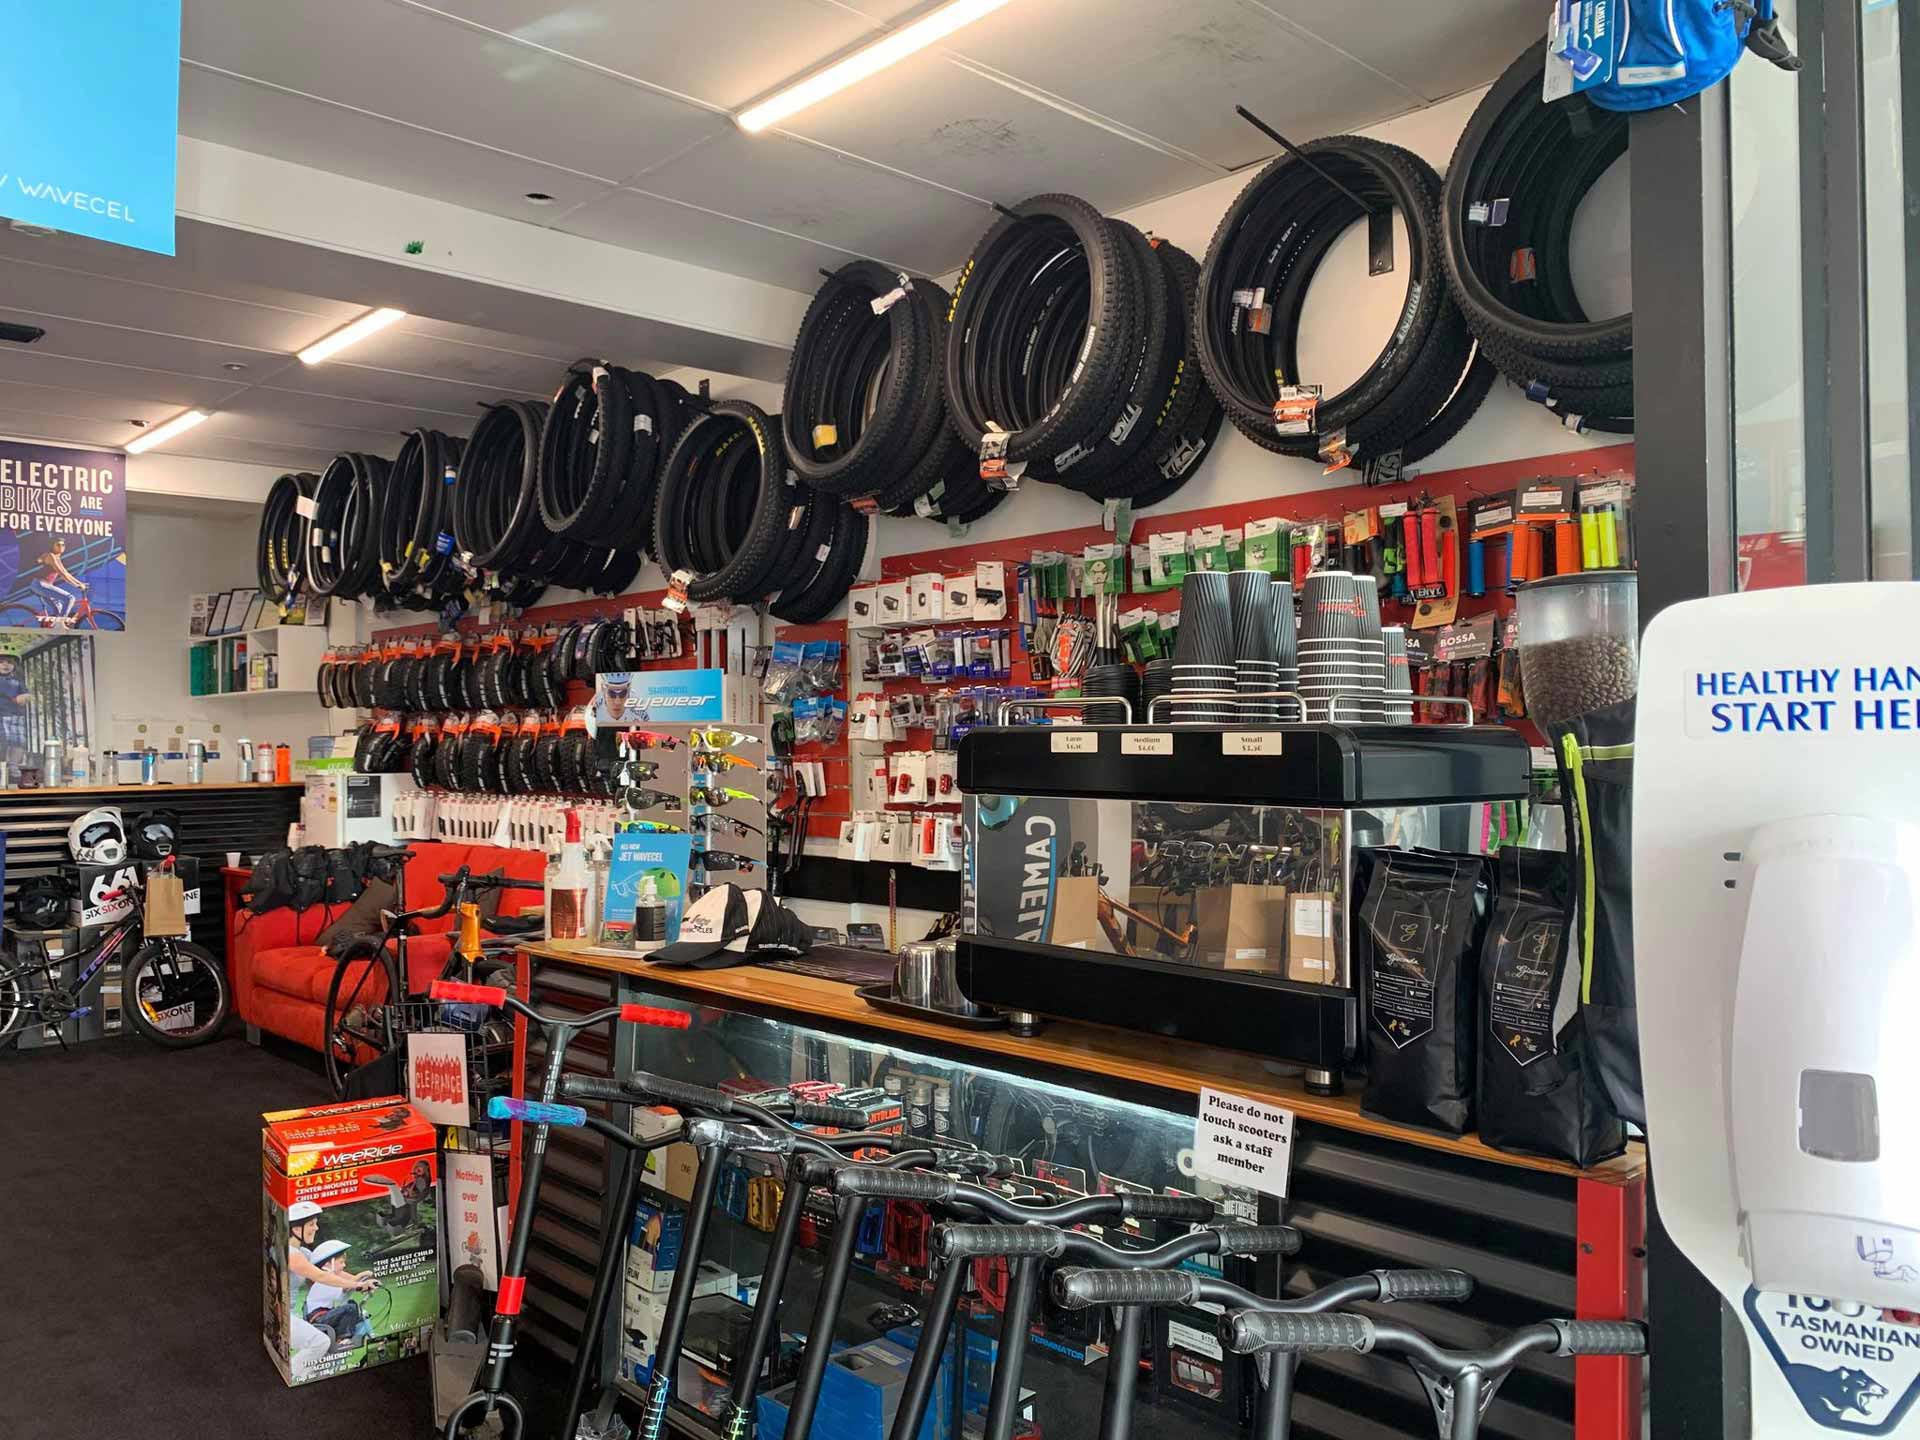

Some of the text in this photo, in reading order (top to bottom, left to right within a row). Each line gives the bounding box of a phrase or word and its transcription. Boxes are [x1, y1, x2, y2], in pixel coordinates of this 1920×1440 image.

[17, 176, 136, 223] WAVECEL
[0, 458, 113, 494] ELECTRIC
[0, 485, 104, 516] BIKES ARE
[0, 512, 113, 537] FOR EVERYONE
[1440, 632, 1477, 649] BOSSA
[1696, 668, 1841, 696] HEALTHY
[624, 695, 717, 711] eyewear
[1711, 700, 1837, 732] START
[618, 852, 633, 862] JET
[1208, 1095, 1285, 1126] Please do not
[1203, 1112, 1289, 1145] touch scooters
[322, 1143, 404, 1167] WeeRide
[1213, 1134, 1274, 1159] ask a staff
[1217, 1152, 1266, 1174] member
[296, 1169, 359, 1188] CLASSIC
[455, 1168, 484, 1186] Nothing
[296, 1187, 359, 1203] CHILD BIKE SEAT
[462, 1192, 479, 1203] over
[401, 1255, 426, 1267] BELIEVE
[413, 1248, 435, 1259] CHILD
[389, 1267, 403, 1275] CAN
[1776, 1311, 1920, 1349] TASMANIAN
[319, 1349, 354, 1364] CHILDREN
[1030, 1334, 1085, 1361] TERMINATOR
[1801, 1334, 1895, 1363] OWNED
